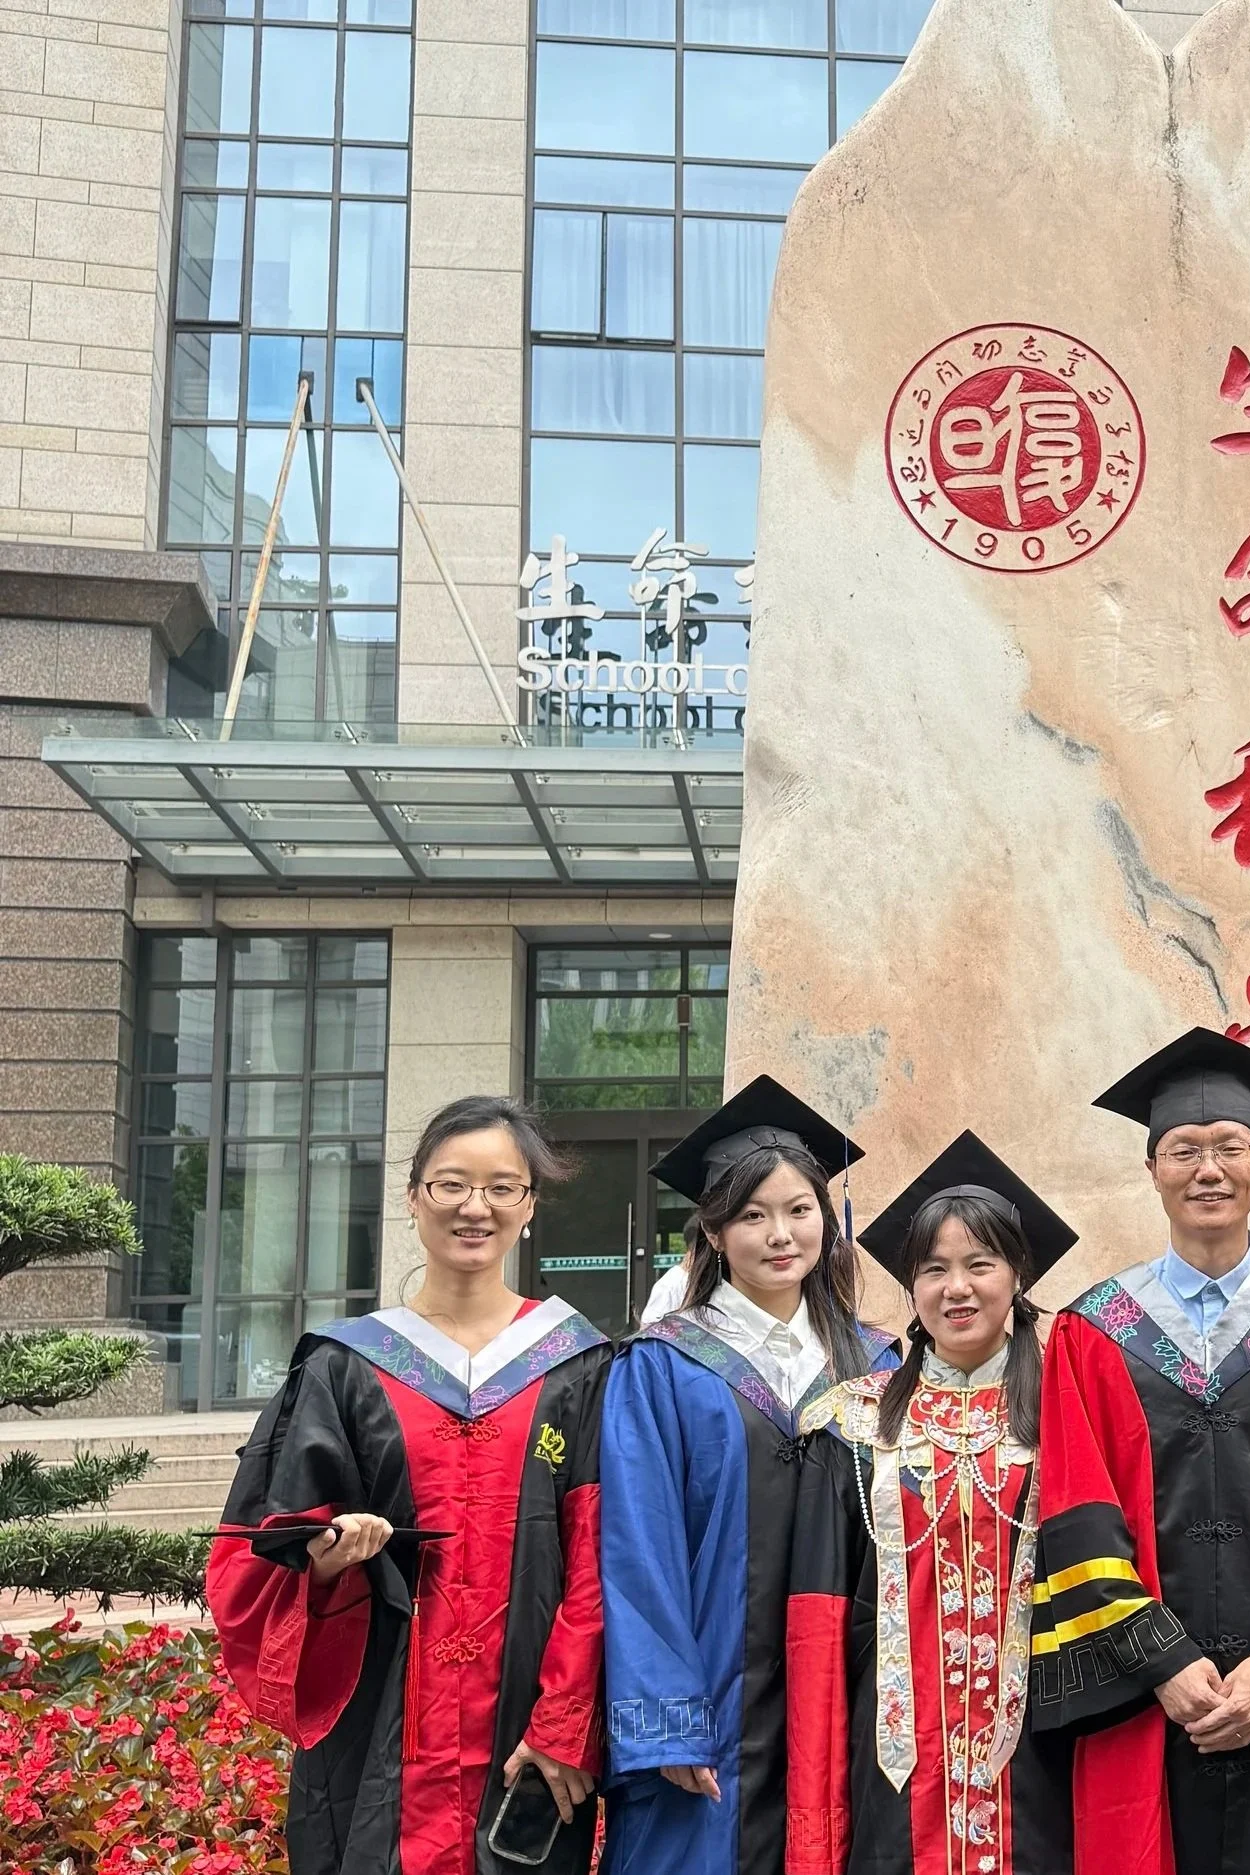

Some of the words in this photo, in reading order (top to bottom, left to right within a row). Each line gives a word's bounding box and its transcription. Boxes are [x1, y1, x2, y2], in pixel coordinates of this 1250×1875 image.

[940, 517, 1093, 563] 1905
[515, 527, 756, 636] 生命
[515, 645, 704, 696] School
